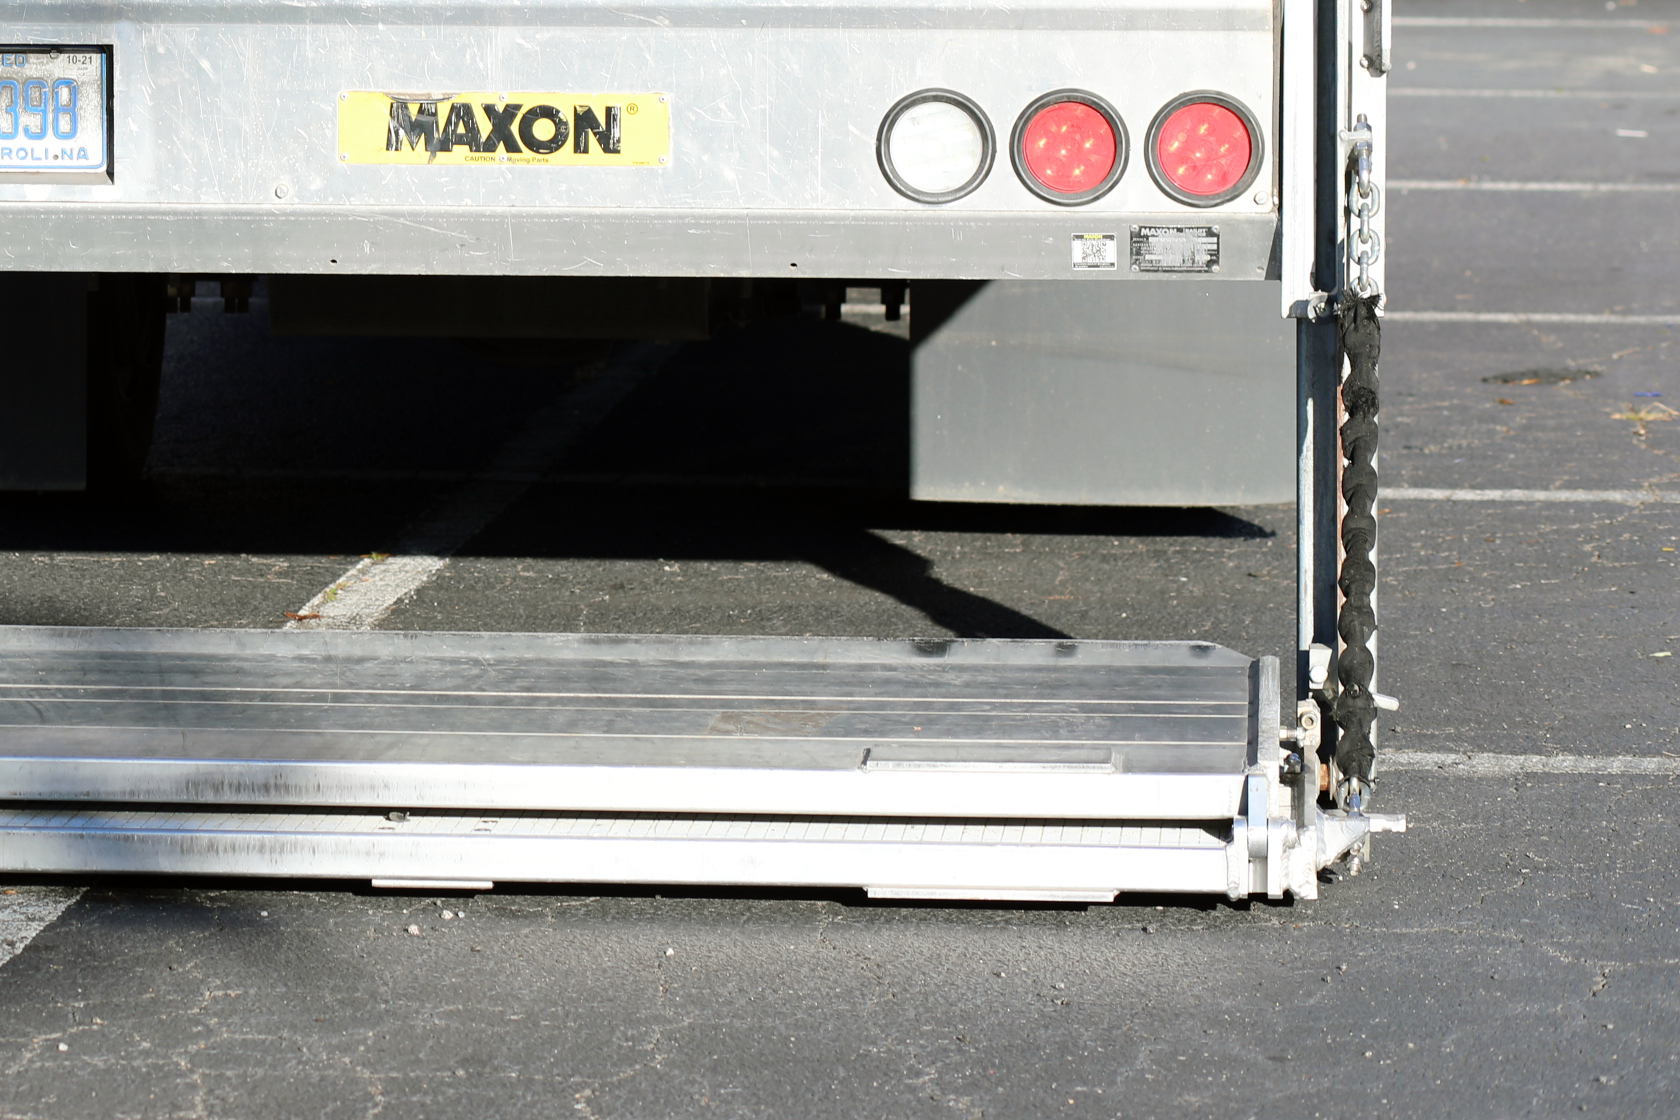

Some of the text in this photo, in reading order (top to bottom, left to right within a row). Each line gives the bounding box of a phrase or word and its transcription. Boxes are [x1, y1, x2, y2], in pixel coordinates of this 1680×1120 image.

[66, 54, 93, 65] 10-21
[385, 100, 622, 155] MAXON
[464, 155, 496, 163] CAUTION
[531, 156, 549, 164] Parts
[1140, 226, 1178, 237] MAXON
